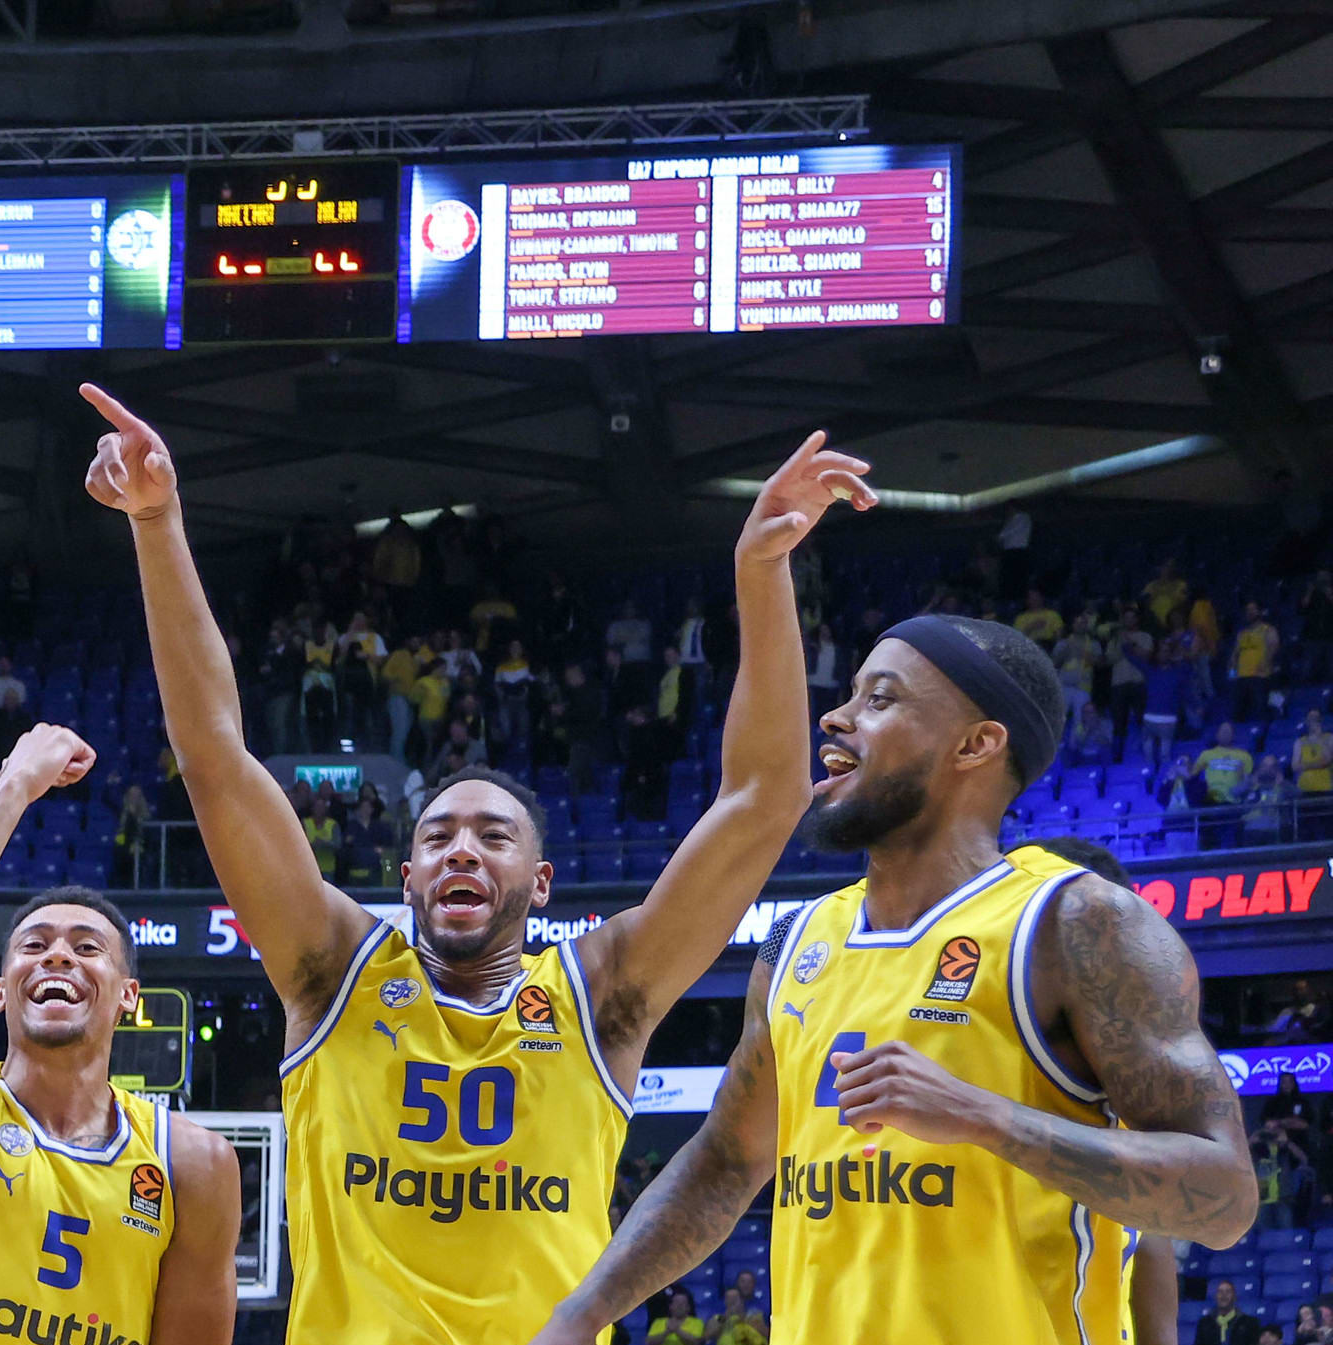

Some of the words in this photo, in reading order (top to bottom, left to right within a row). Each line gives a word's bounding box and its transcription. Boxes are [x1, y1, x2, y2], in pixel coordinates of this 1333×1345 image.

[564, 184, 631, 204] BRANDON
[797, 176, 835, 195] BILLY
[785, 226, 866, 246] GIAMPAOLO
[803, 252, 862, 271] SHAVON
[924, 248, 942, 267] 14
[569, 261, 609, 279] KEVIN
[558, 286, 617, 305] STEFANO
[787, 279, 822, 297] KYLE
[1185, 868, 1325, 920] PLAY
[206, 908, 239, 956] 5
[935, 980, 968, 989] TURKISH
[909, 1007, 968, 1025] oneteam
[519, 1039, 562, 1051] oneteam
[1250, 1051, 1331, 1076] ARAD
[398, 1060, 515, 1147] 50
[344, 1151, 570, 1224] Playtika
[121, 1215, 160, 1236] oneteam
[37, 1209, 91, 1290] 5
